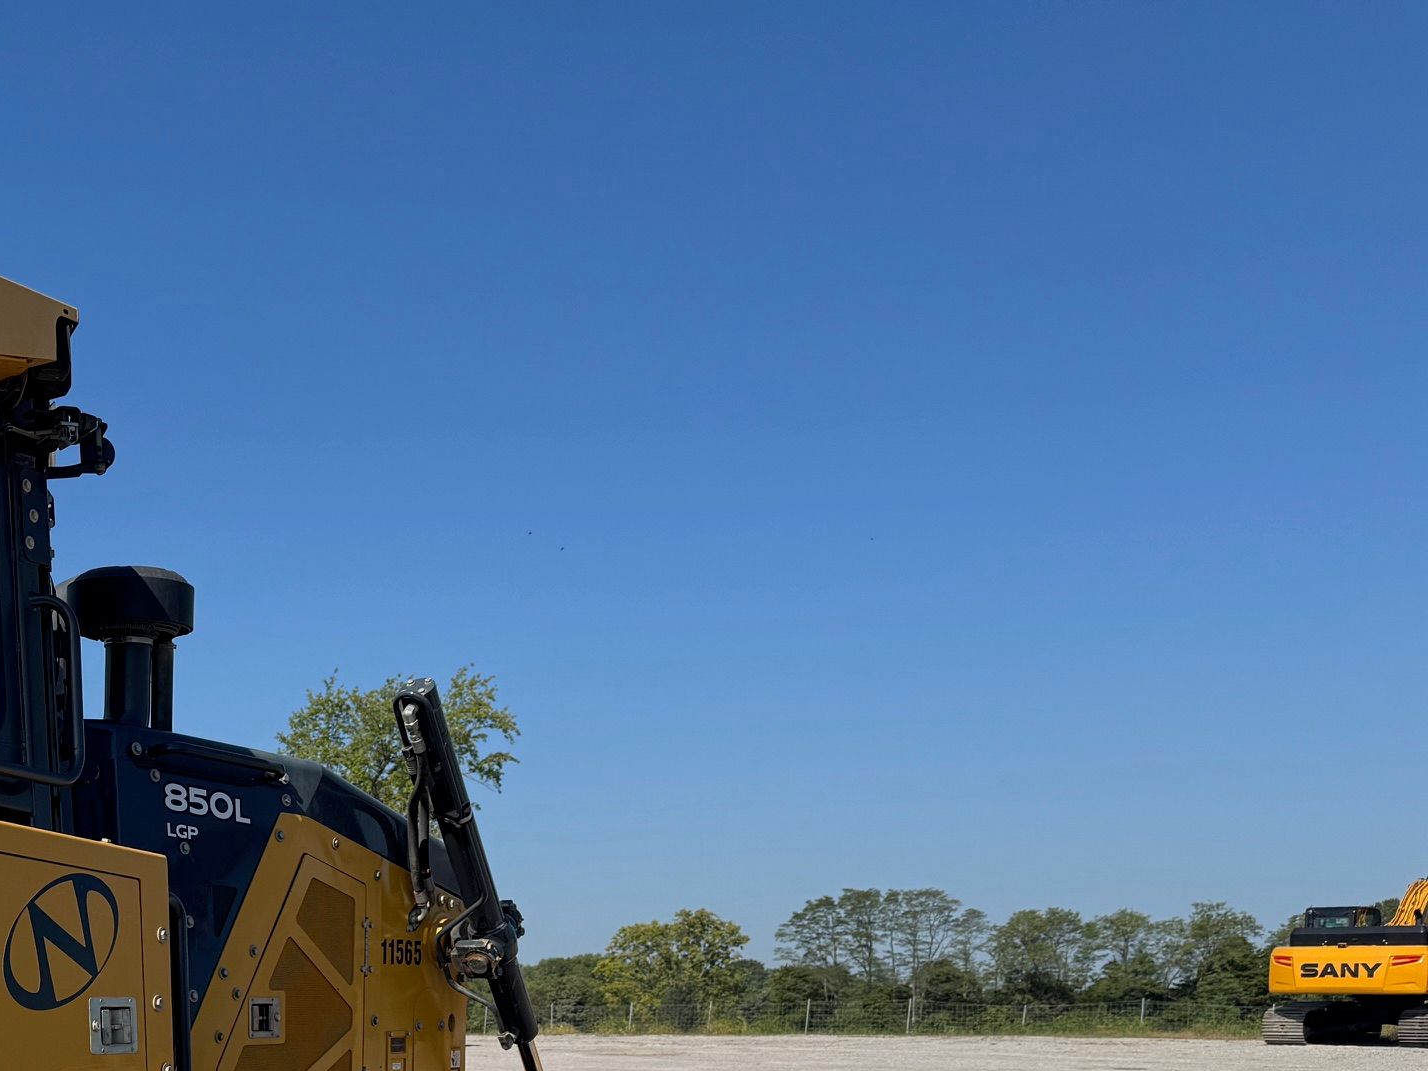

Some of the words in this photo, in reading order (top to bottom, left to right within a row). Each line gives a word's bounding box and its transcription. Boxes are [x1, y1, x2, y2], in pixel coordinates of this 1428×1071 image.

[165, 783, 251, 824] 850L
[167, 822, 199, 840] LGP
[381, 938, 422, 966] 11565
[1300, 963, 1383, 978] SANY
